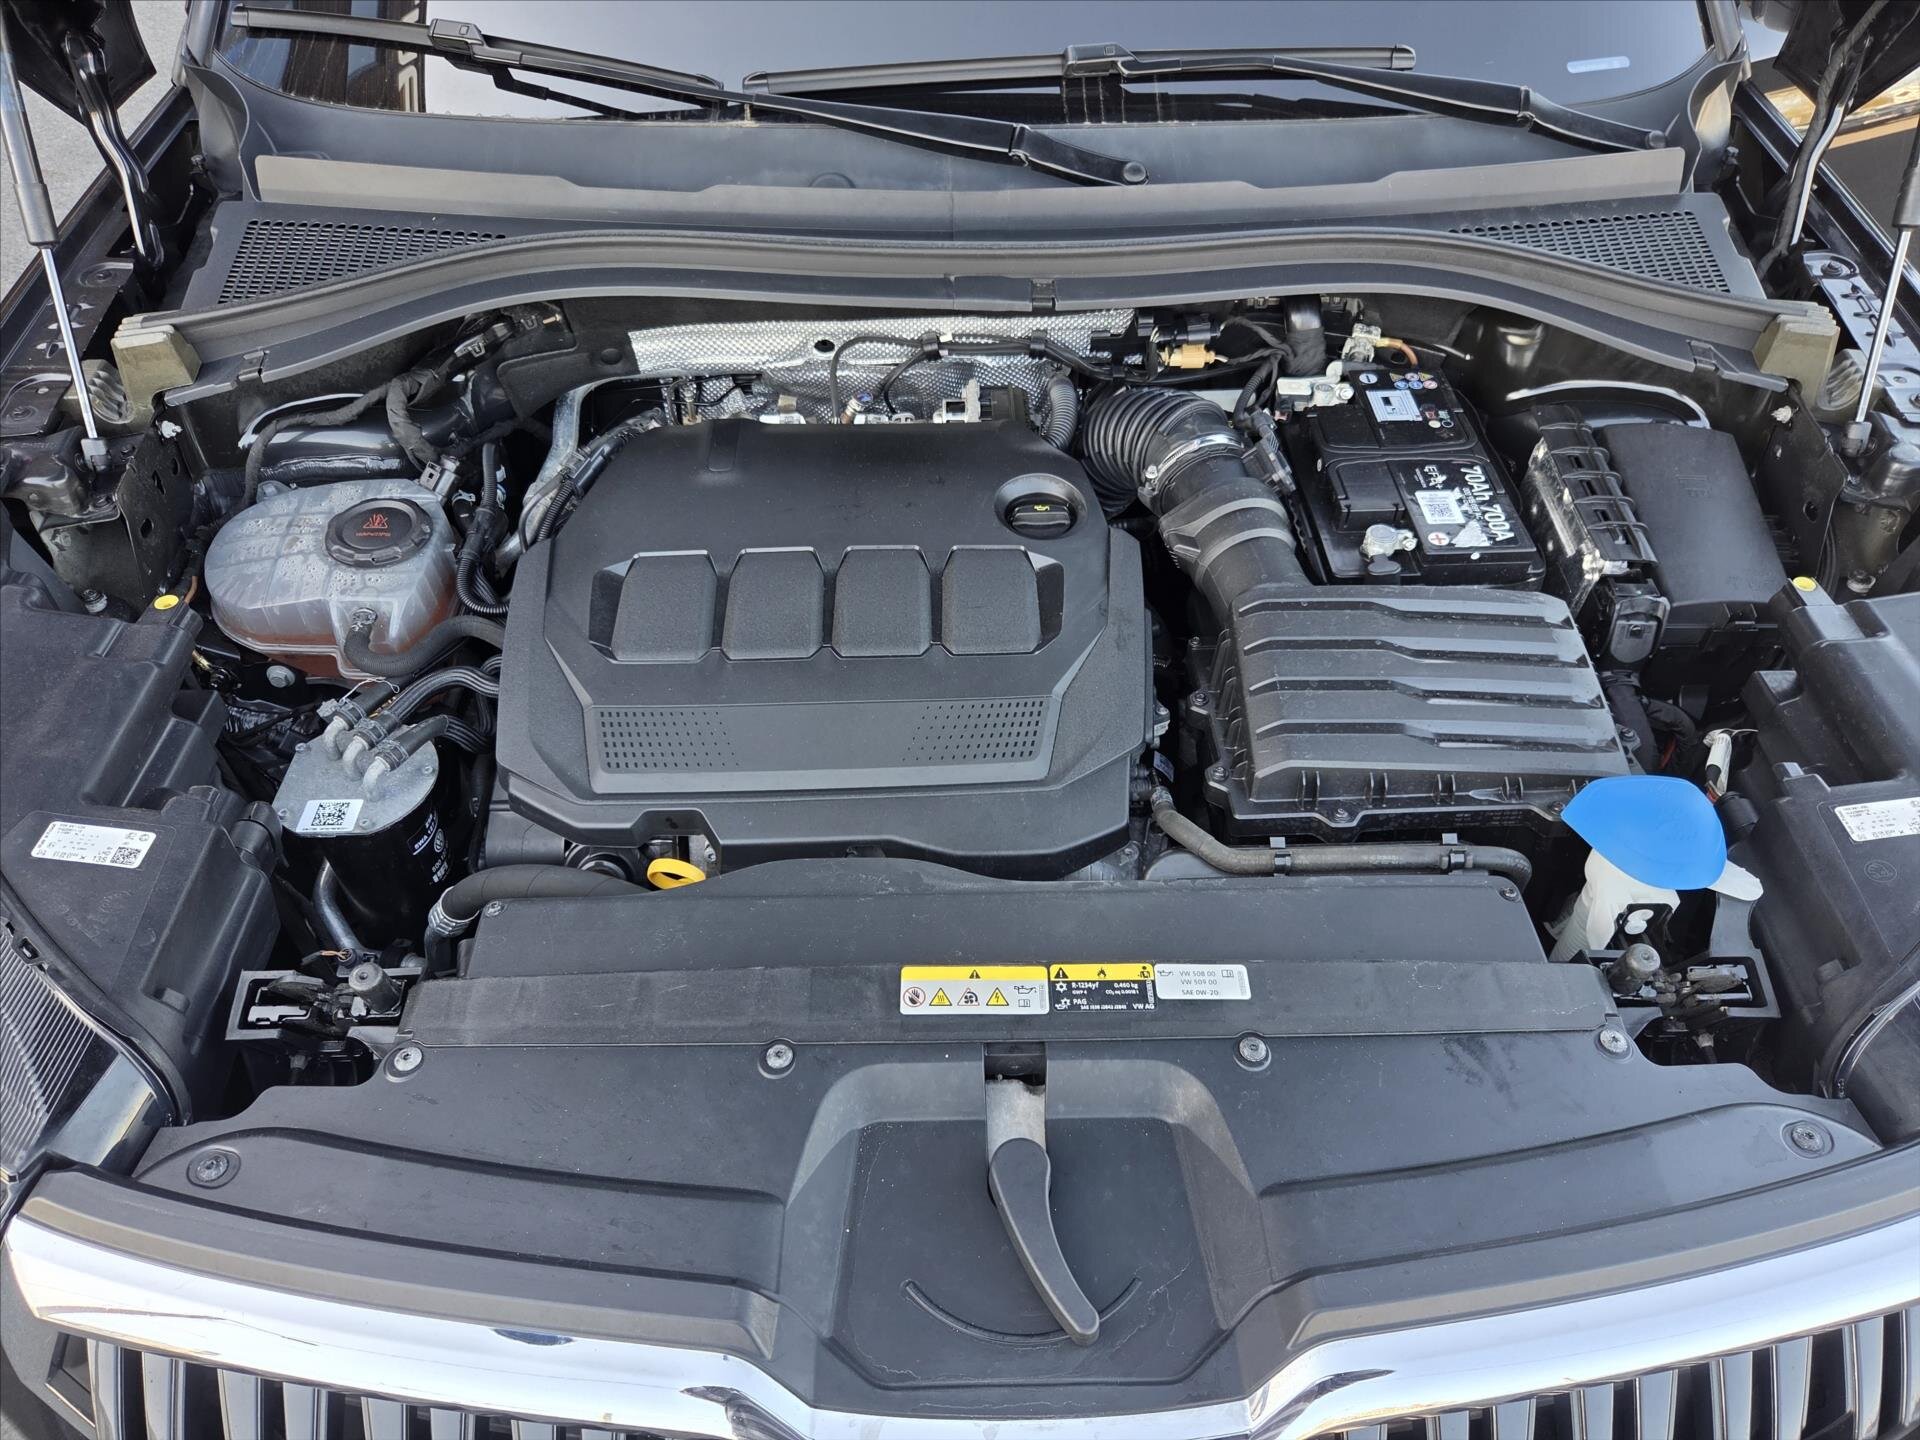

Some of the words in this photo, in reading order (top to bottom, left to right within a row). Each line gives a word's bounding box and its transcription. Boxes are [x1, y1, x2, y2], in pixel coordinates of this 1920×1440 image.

[1460, 465, 1494, 501] 70Ah
[1479, 503, 1515, 542] 700A
[1071, 981, 1099, 990] R-1234yf
